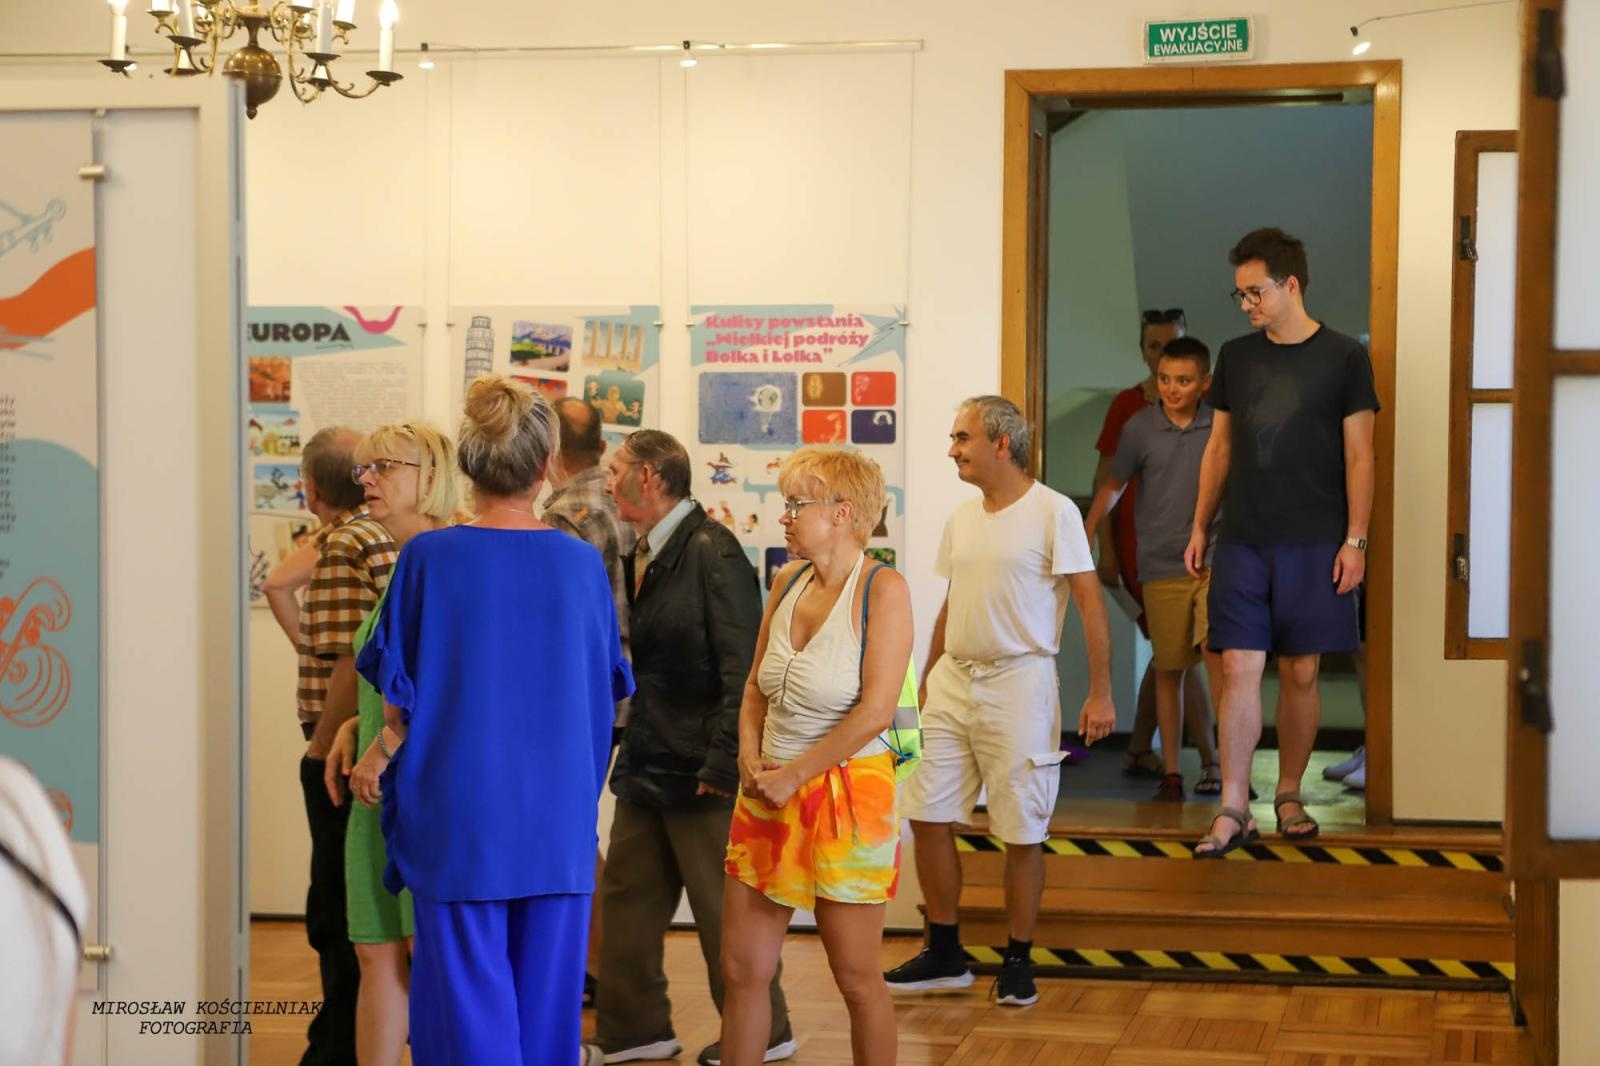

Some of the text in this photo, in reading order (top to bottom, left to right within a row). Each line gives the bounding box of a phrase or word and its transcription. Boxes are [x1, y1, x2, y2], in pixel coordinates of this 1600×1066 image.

[1160, 23, 1237, 42] WYJŚCIE
[1154, 39, 1243, 56] EWAKUACYJNE
[705, 313, 865, 331] Kulisy powstania
[248, 322, 352, 342] UROPA
[793, 331, 869, 348] podróży
[705, 349, 759, 363] Bolka
[763, 348, 768, 363] i
